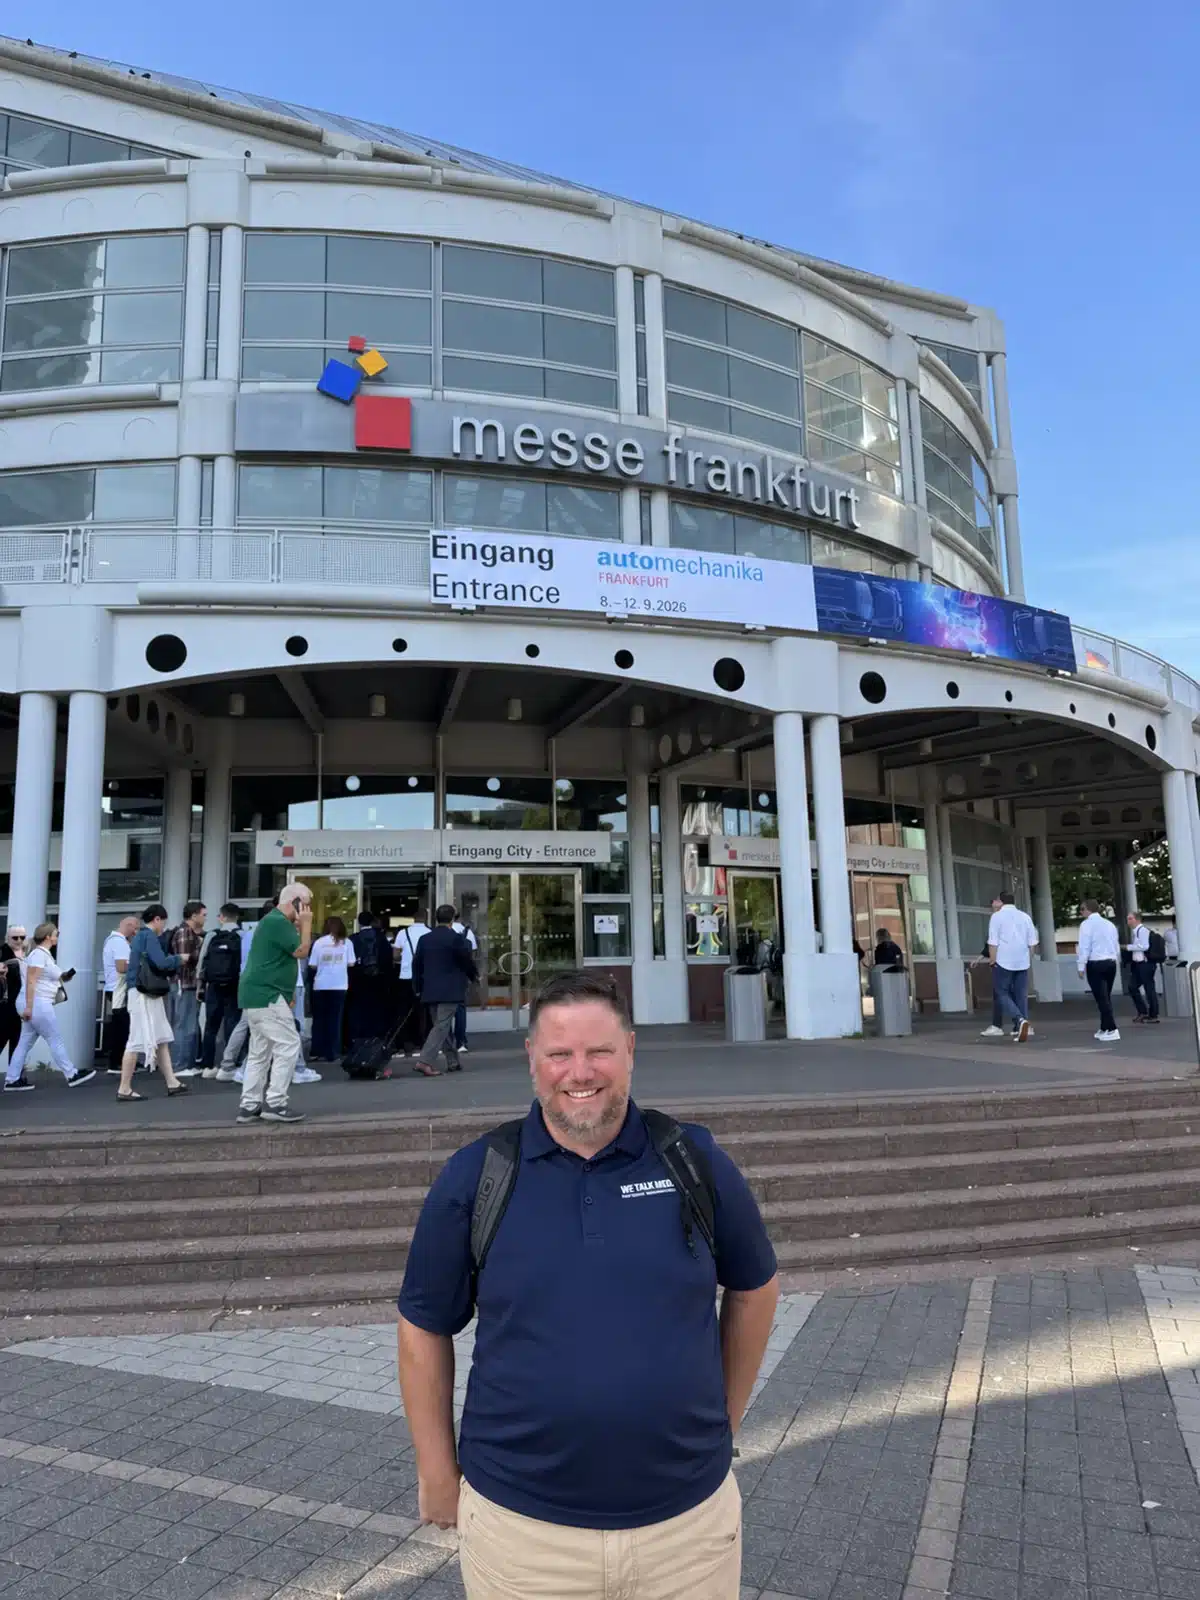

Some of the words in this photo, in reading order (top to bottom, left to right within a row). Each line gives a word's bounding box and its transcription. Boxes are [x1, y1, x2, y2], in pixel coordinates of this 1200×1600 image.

[453, 416, 645, 476] messe
[663, 433, 861, 529] frankfurt
[431, 535, 554, 571] Eingang
[597, 551, 763, 582] automechanika
[432, 573, 560, 604] Entrance
[599, 572, 669, 589] FRANKFURT
[302, 848, 344, 858] messe
[347, 845, 404, 858] frankfurt
[449, 844, 502, 859] Eingang
[507, 844, 532, 859] City
[544, 845, 596, 857] Entrance
[620, 1184, 635, 1194] WE
[634, 1181, 655, 1192] TALK
